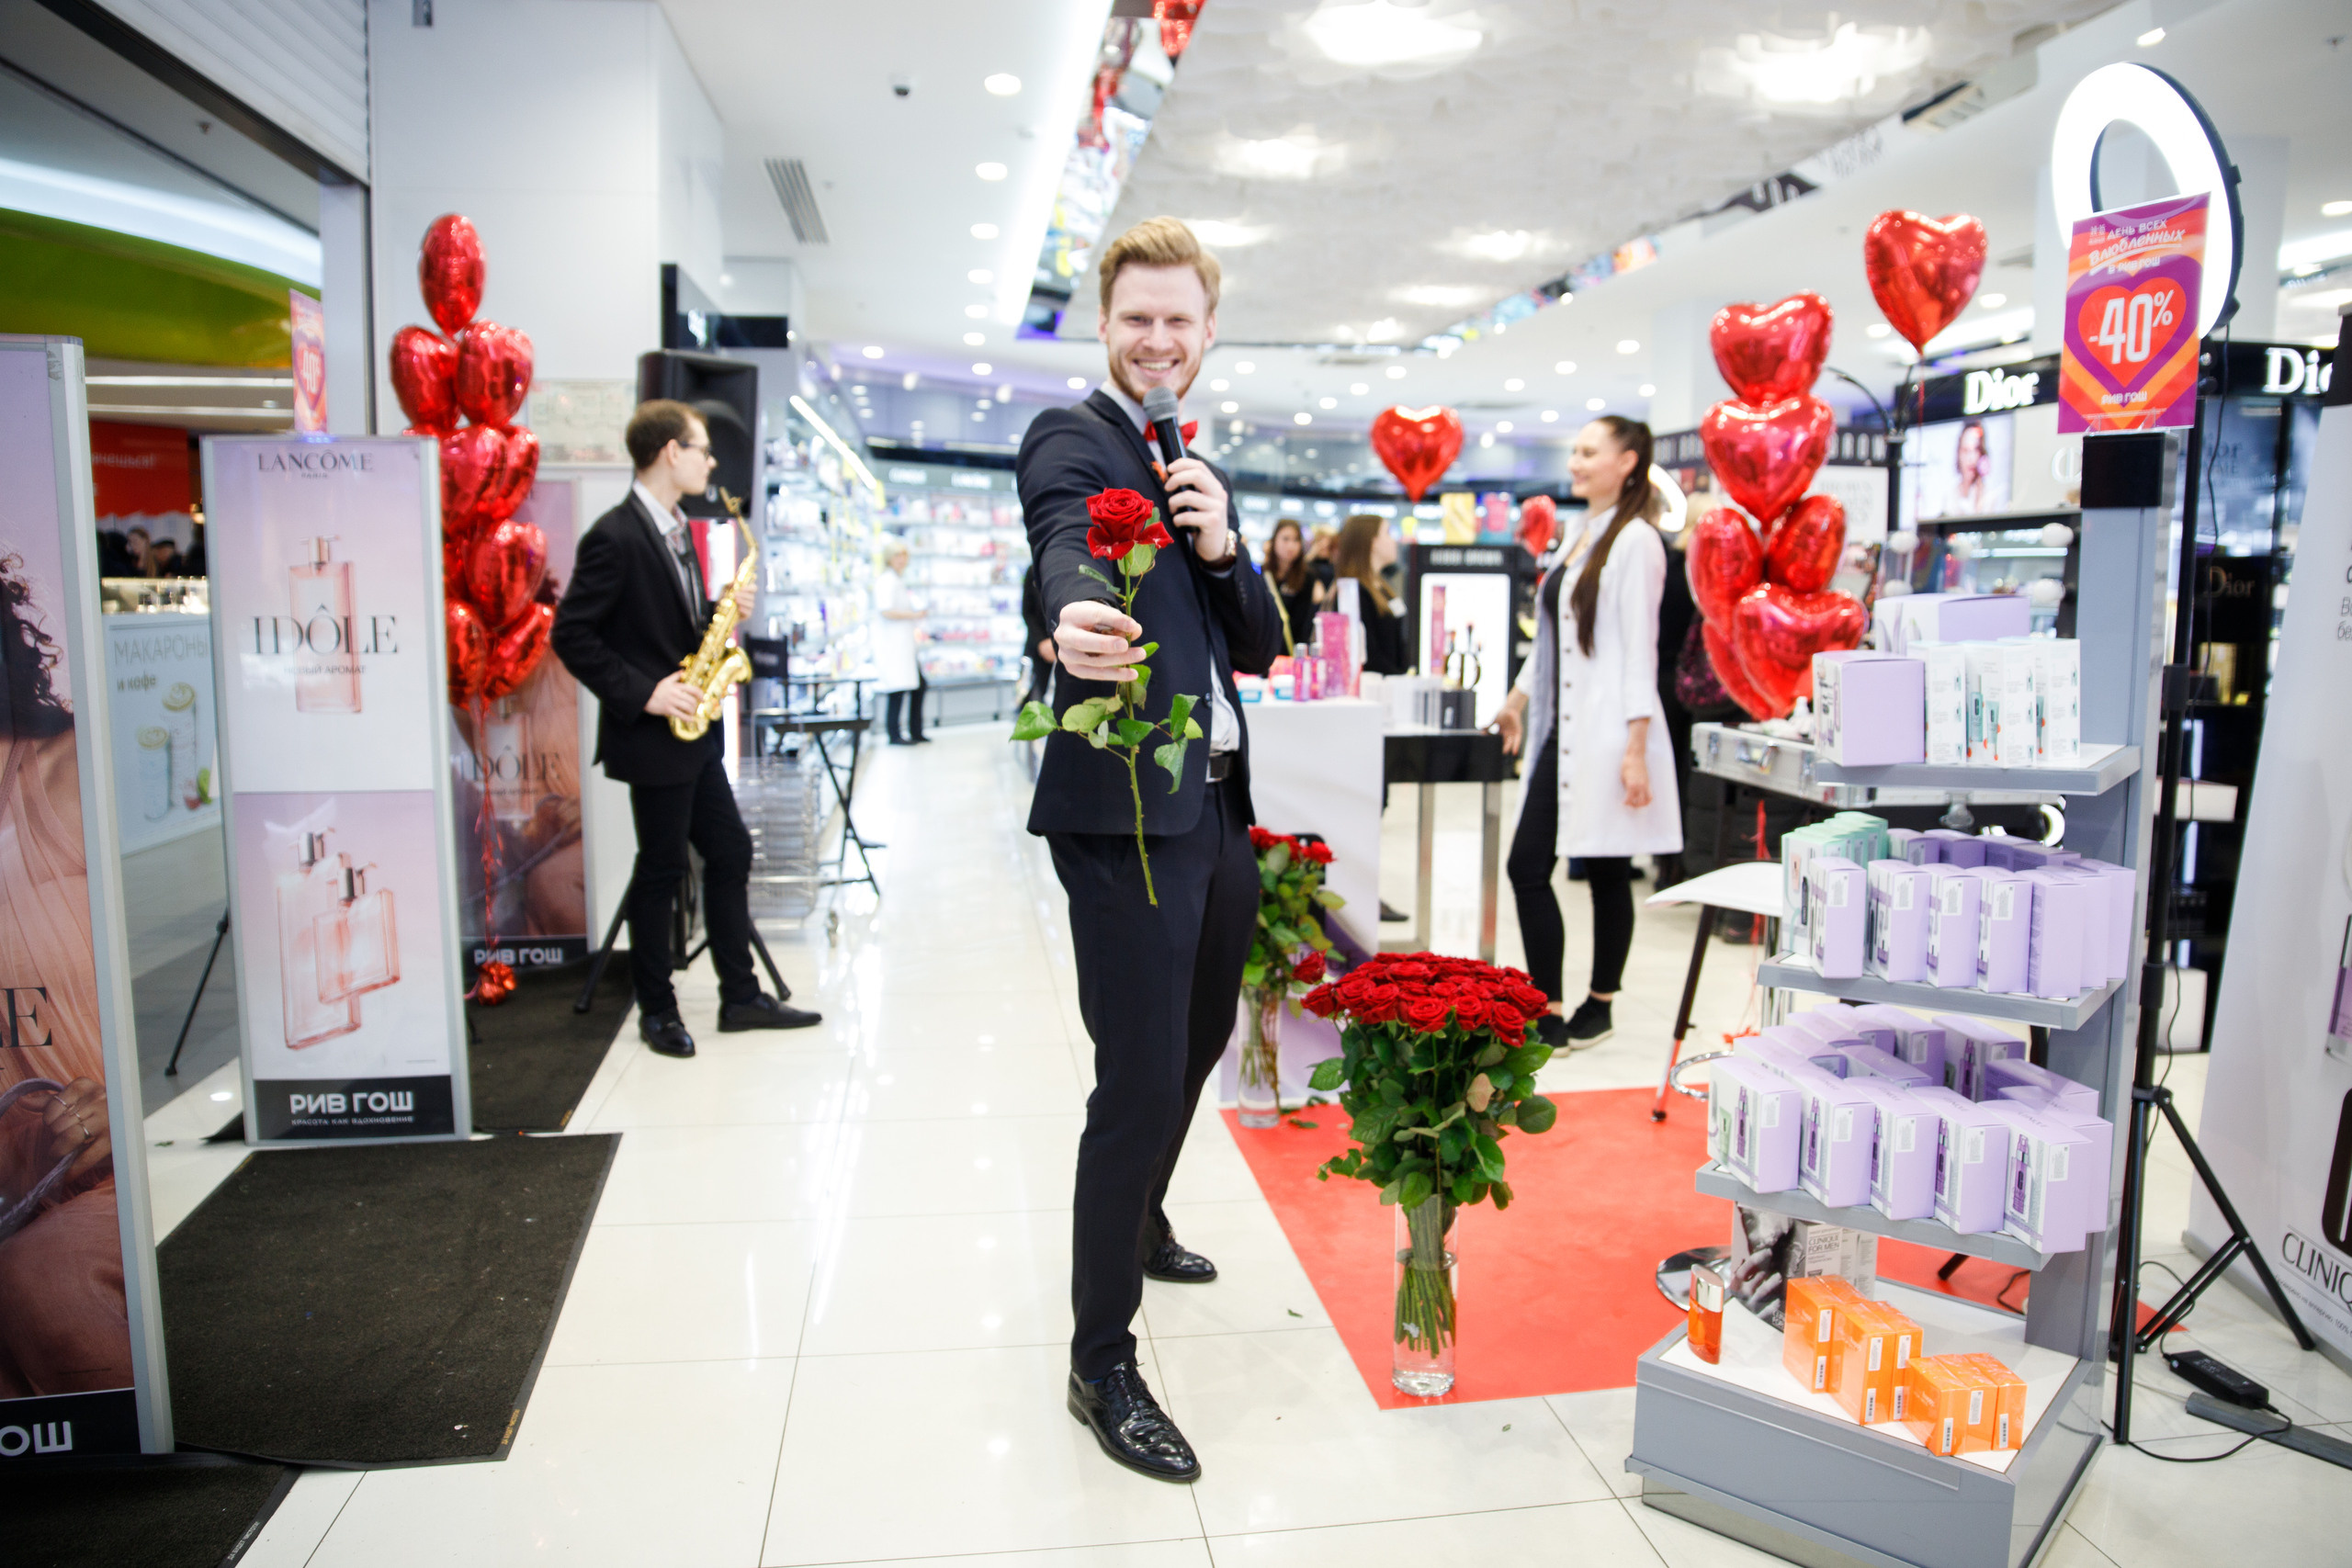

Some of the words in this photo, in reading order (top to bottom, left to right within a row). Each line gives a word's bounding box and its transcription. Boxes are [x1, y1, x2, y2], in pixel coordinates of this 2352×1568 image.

[2138, 219, 2168, 233] ВСЕХ
[1964, 367, 2040, 414] Dior
[258, 449, 374, 471] LANCÔME
[2204, 566, 2256, 596] Dior
[251, 602, 399, 655] IDÔLE
[324, 664, 368, 674] АРОМАТ
[519, 947, 563, 965] ГОШ
[289, 1093, 347, 1114] РИВ
[353, 1091, 413, 1113] ГОШ
[352, 1116, 413, 1125] ВДОХНОВЕНИЕ
